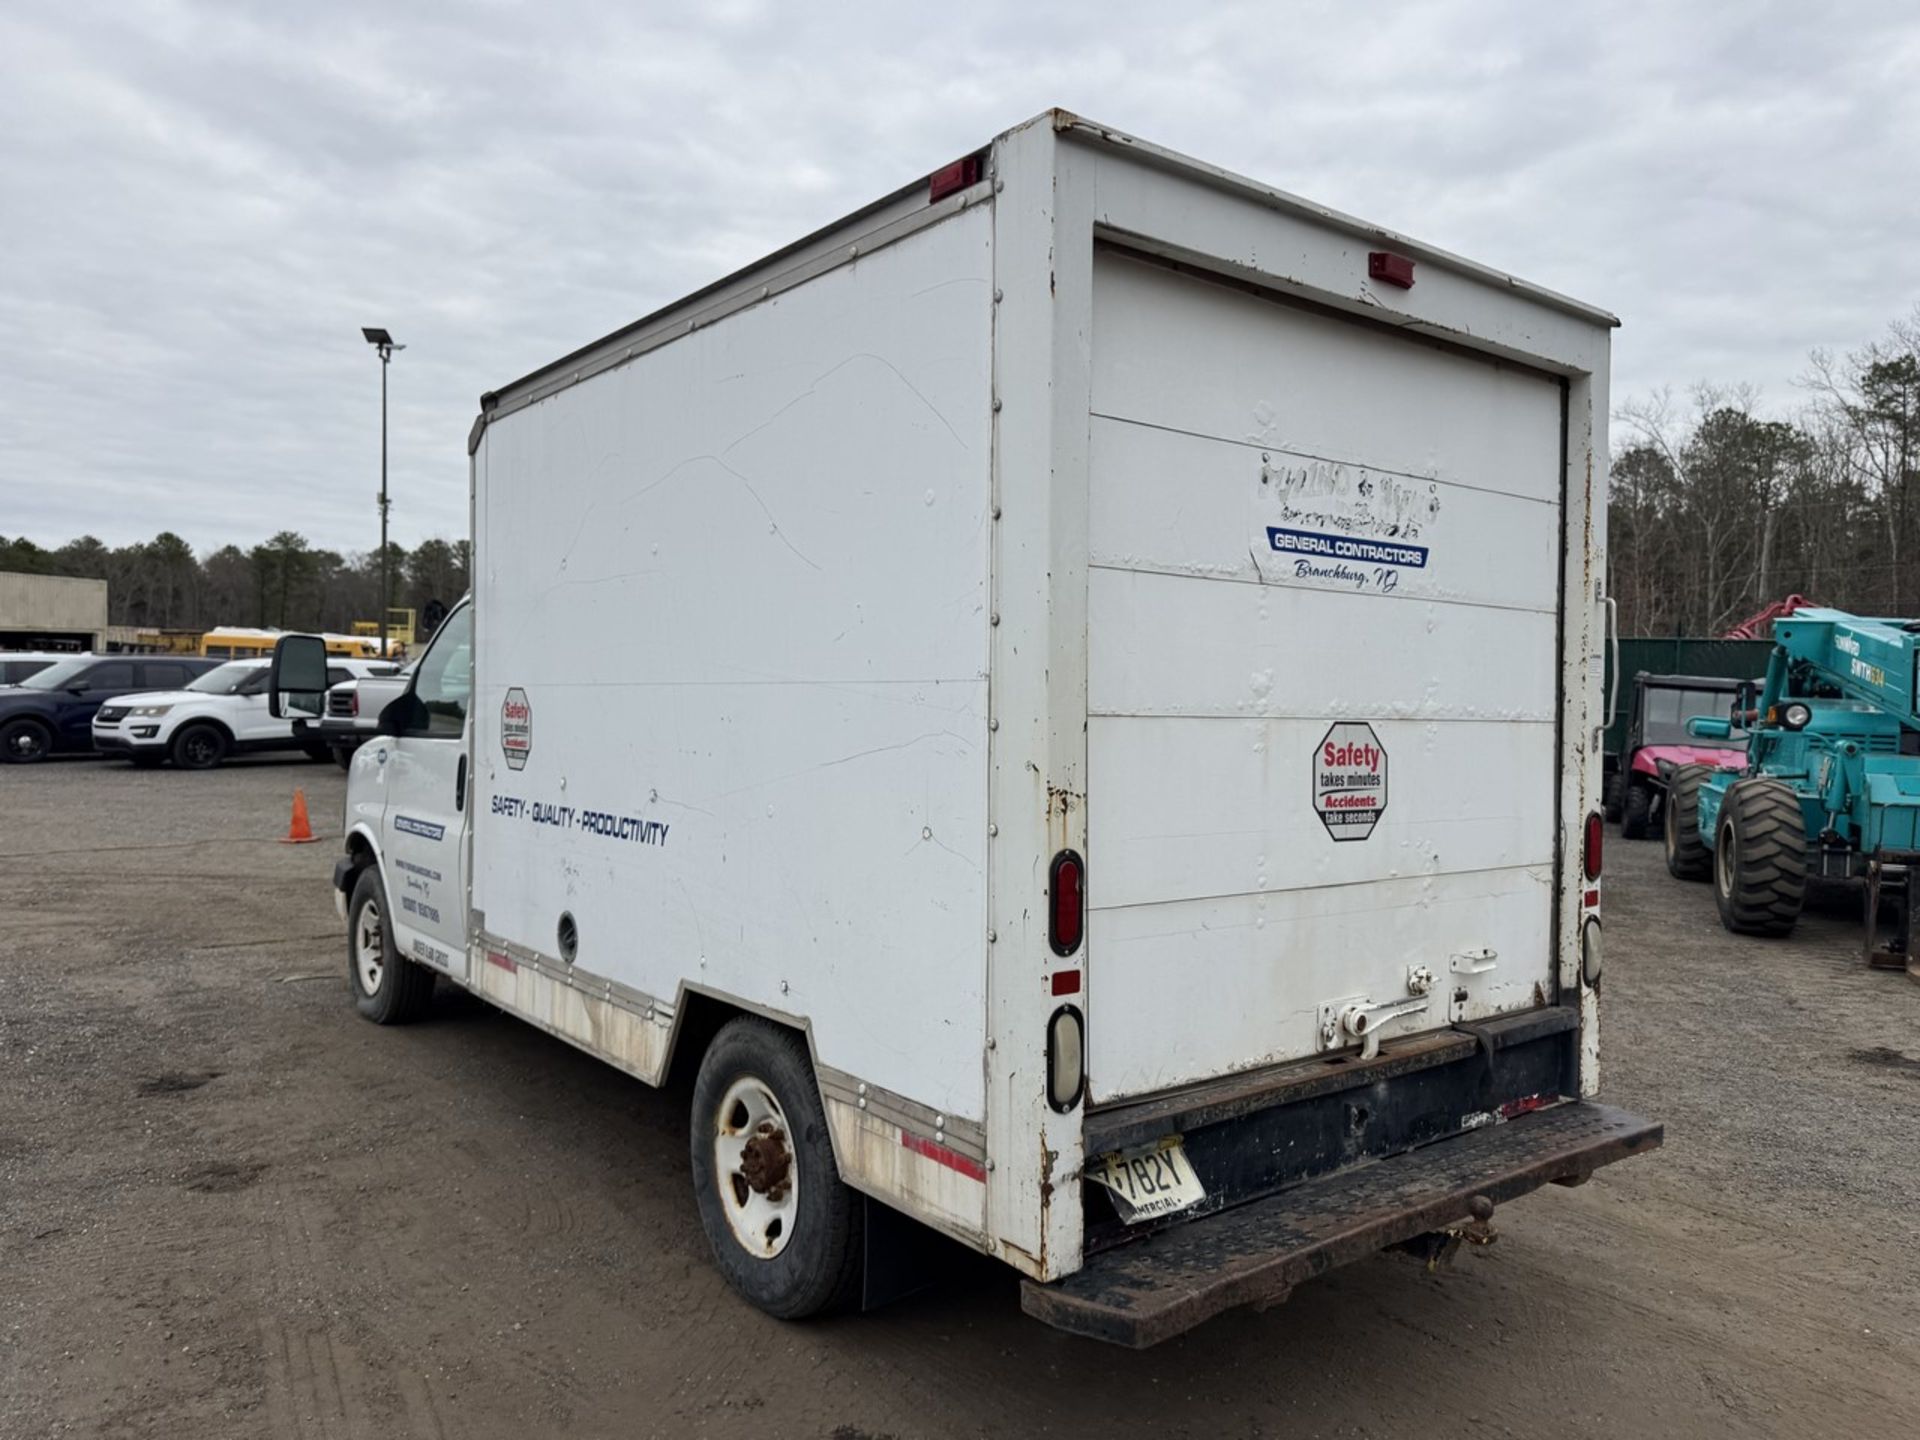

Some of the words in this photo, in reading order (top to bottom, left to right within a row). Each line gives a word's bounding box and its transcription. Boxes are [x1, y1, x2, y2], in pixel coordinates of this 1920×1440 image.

[1274, 533, 1334, 554] GENERAL
[1335, 542, 1423, 565] CONTRACTORS
[1294, 559, 1369, 589] Branchburg,
[1373, 568, 1399, 593] NJ
[1323, 741, 1380, 772] Safety
[1320, 772, 1345, 787] takes
[1347, 772, 1381, 787] minutes
[1325, 795, 1377, 808] Accidents
[1325, 811, 1343, 824] take
[1345, 810, 1376, 824] seconds
[491, 795, 526, 818] SAFETY
[532, 802, 575, 828] QUALITY
[582, 810, 670, 847] PRODUCTIVITY
